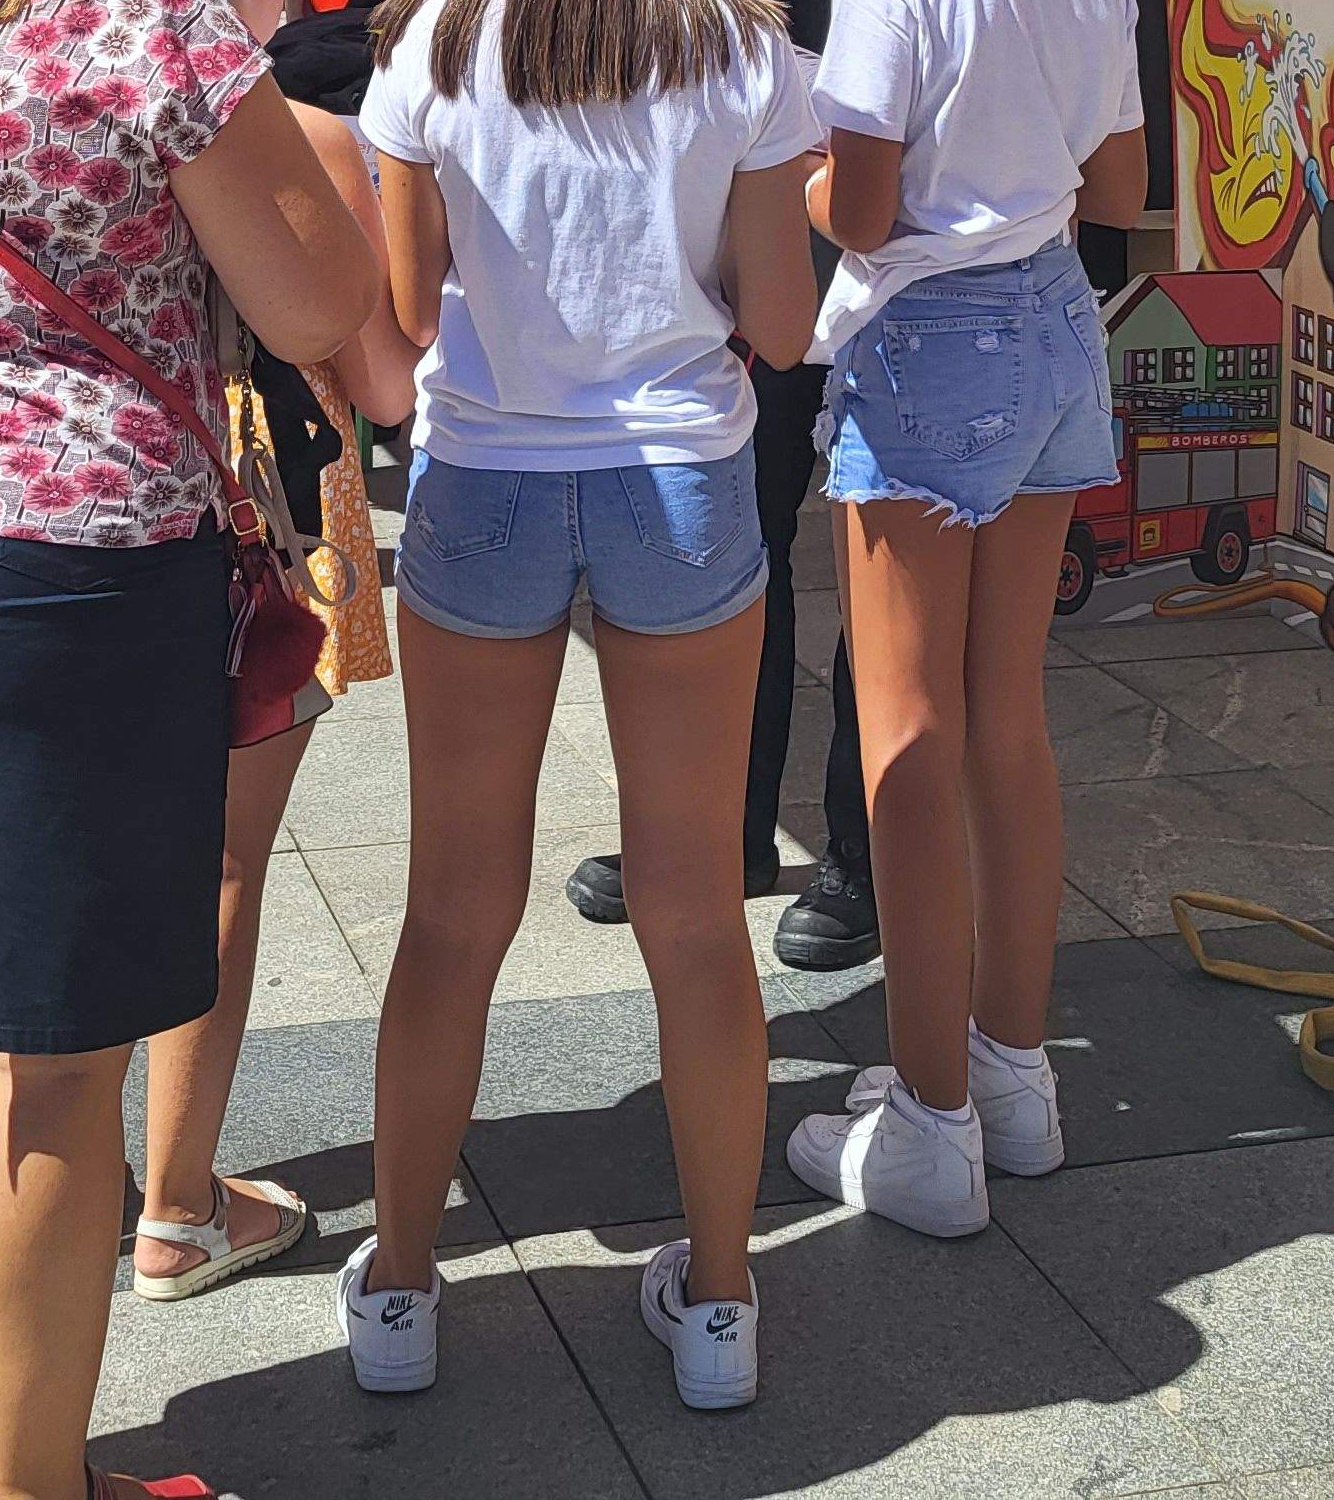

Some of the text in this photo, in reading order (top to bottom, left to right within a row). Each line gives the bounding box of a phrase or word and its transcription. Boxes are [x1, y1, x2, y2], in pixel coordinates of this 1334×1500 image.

[1171, 434, 1247, 447] BOMBEROS
[387, 1292, 414, 1311] NIKE
[713, 1305, 740, 1322] NIKE
[390, 1318, 414, 1332] AIR
[714, 1331, 738, 1343] AIR
